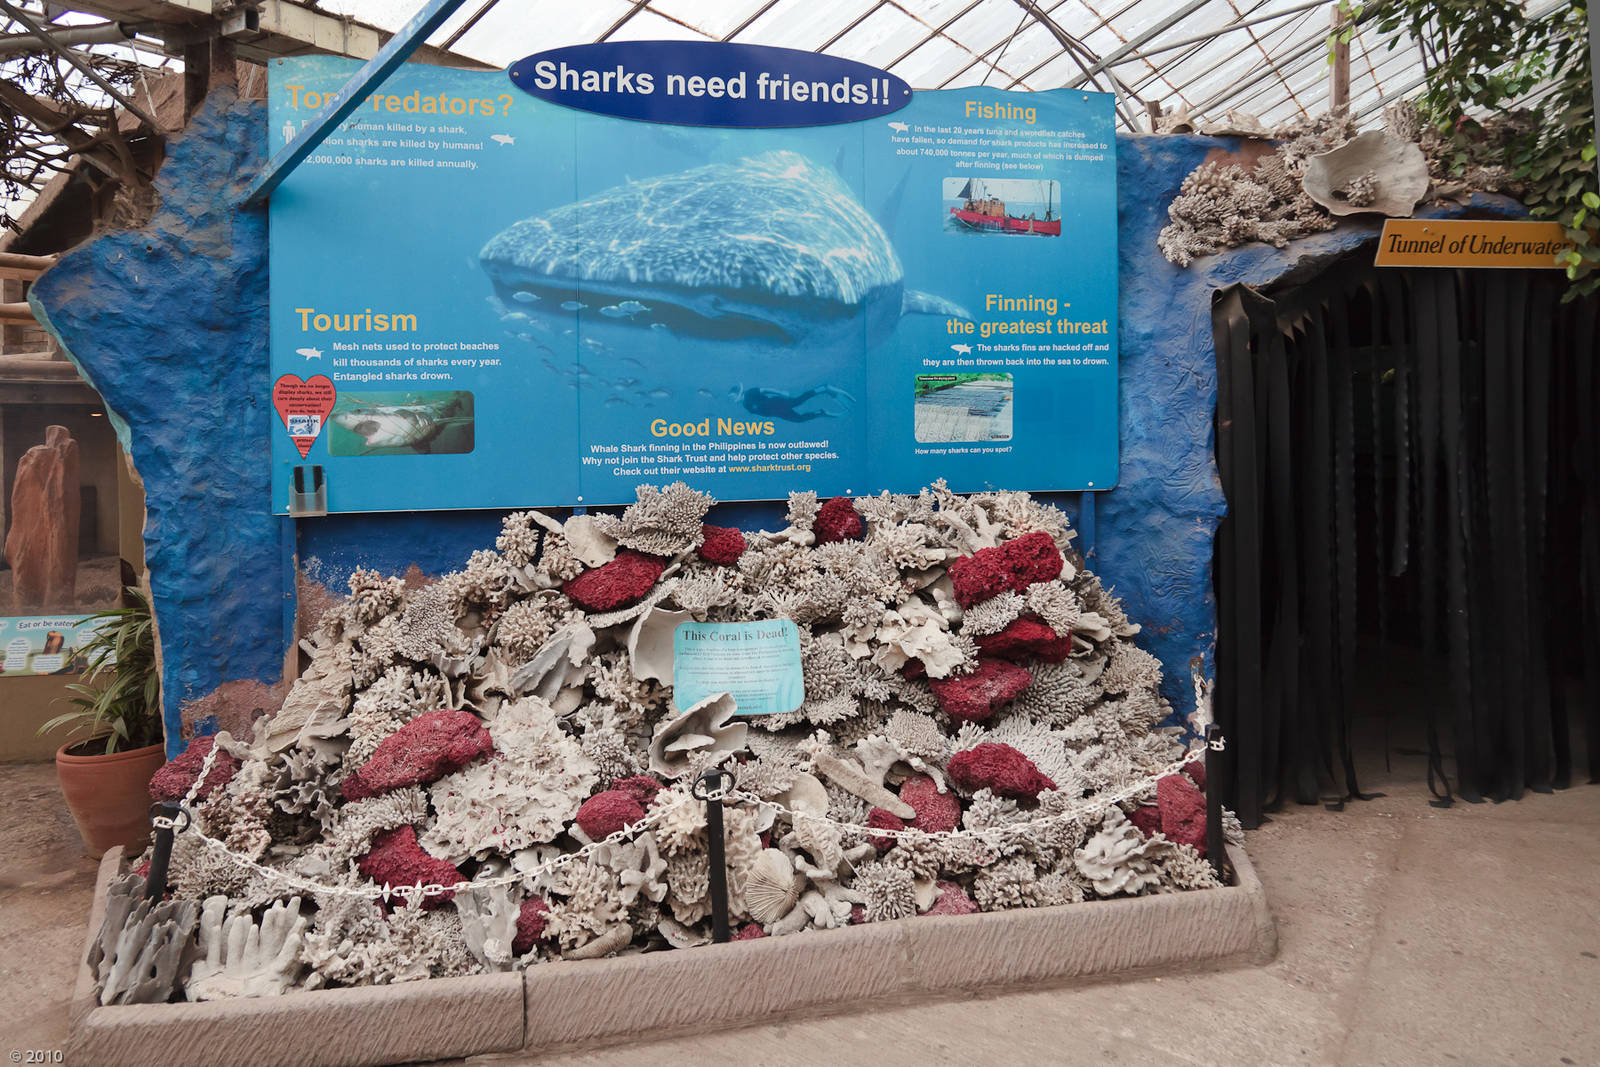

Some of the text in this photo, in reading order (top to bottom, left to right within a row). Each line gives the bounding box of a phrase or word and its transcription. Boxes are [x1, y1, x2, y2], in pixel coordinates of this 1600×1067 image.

[534, 60, 889, 106] Sharks need friends!!
[365, 90, 514, 117] redators?
[965, 101, 1037, 124] Fishing
[349, 121, 384, 131] human
[386, 123, 413, 132] killed
[415, 124, 428, 134] by
[437, 125, 467, 135] shark,
[914, 125, 922, 133] In
[938, 126, 951, 134] last
[953, 126, 962, 134] 20
[964, 128, 985, 136] years
[986, 128, 1002, 136] tuna
[1004, 128, 1018, 136] and
[1057, 131, 1086, 139] catches
[346, 137, 379, 148] sharks
[400, 139, 426, 148] killed
[428, 140, 440, 150] by
[442, 140, 483, 151] humans!
[891, 135, 910, 143] have
[911, 136, 935, 145] fallen,
[947, 137, 978, 145] demand
[979, 138, 990, 146] for
[991, 139, 1012, 147] shark
[1014, 140, 1047, 149] products
[1048, 140, 1062, 148] has
[896, 147, 918, 156] about
[920, 148, 949, 157] 740,000
[950, 149, 976, 157] tonnes
[977, 152, 990, 160] per
[991, 152, 1010, 160] year,
[1011, 151, 1032, 159] much
[1033, 151, 1041, 160] of
[1042, 152, 1064, 160] which
[1074, 153, 1104, 163] dumped
[355, 157, 388, 167] sharks
[408, 158, 434, 167] killed
[436, 159, 479, 170] annually.
[955, 160, 1044, 171] after finning (see below)
[1388, 234, 1445, 253] Tunnel
[1448, 235, 1469, 253] of
[985, 294, 1058, 316] Finning
[294, 308, 417, 332] Tourism
[946, 318, 1107, 338] the greatest threat
[332, 342, 359, 351] Mesh
[361, 343, 383, 351] nets
[385, 342, 409, 350] used
[423, 342, 458, 352] protect
[459, 342, 499, 350] beaches
[977, 344, 992, 352] The
[993, 344, 1020, 352] sharks
[1082, 343, 1093, 351] off
[332, 357, 504, 368] kill thousands of sharks every year.
[922, 358, 941, 368] they
[956, 358, 975, 366] then
[975, 358, 1004, 366] thrown
[1005, 358, 1025, 366] back
[1025, 358, 1042, 366] into
[1082, 357, 1109, 365] drown.
[333, 371, 453, 382] Entangled sharks drown.
[650, 417, 775, 437] Good News
[590, 444, 618, 453] Whale
[620, 444, 646, 452] Shark
[649, 443, 680, 454] finning
[682, 443, 690, 451] in
[692, 442, 706, 451] the
[708, 442, 757, 452] Philippines
[758, 441, 766, 450] is
[788, 440, 829, 449] outlawed!
[995, 446, 1012, 454] spot?
[582, 451, 839, 467] Why not join the Shark Trust and help protect other species.
[613, 463, 811, 476] Check out their website at www.sharktrust.org
[682, 626, 789, 641] This Coral is Dead!
